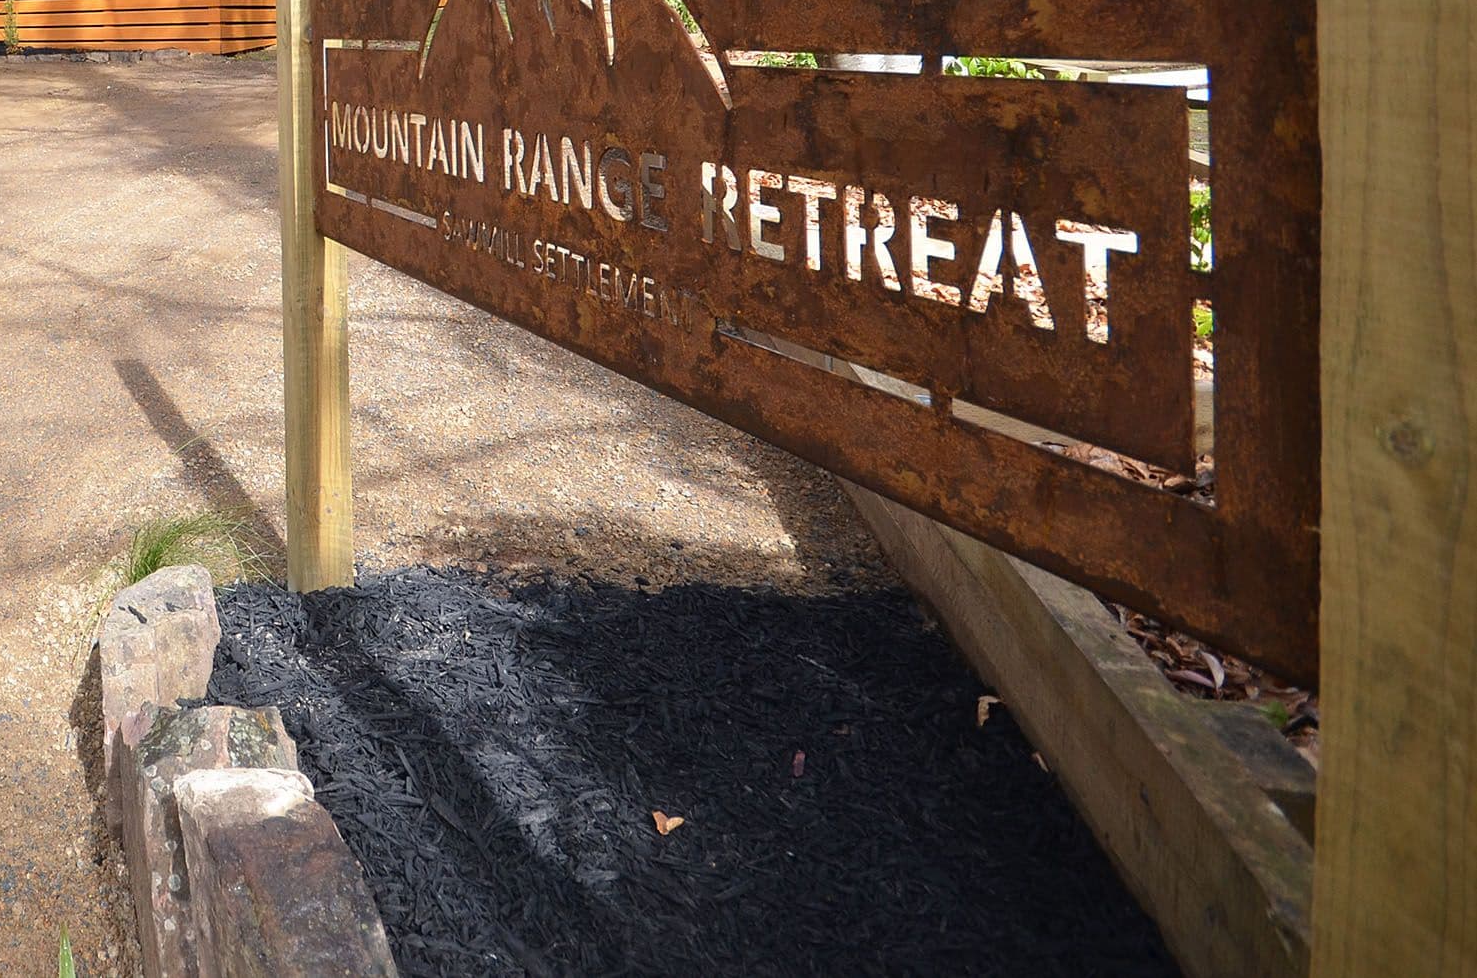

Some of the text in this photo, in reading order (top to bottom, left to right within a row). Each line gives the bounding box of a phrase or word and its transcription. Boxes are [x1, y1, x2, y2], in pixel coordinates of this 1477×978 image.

[330, 101, 1139, 345] MOUNTAIN RANGE RETREAT
[532, 238, 699, 333] SETTLEMENT
